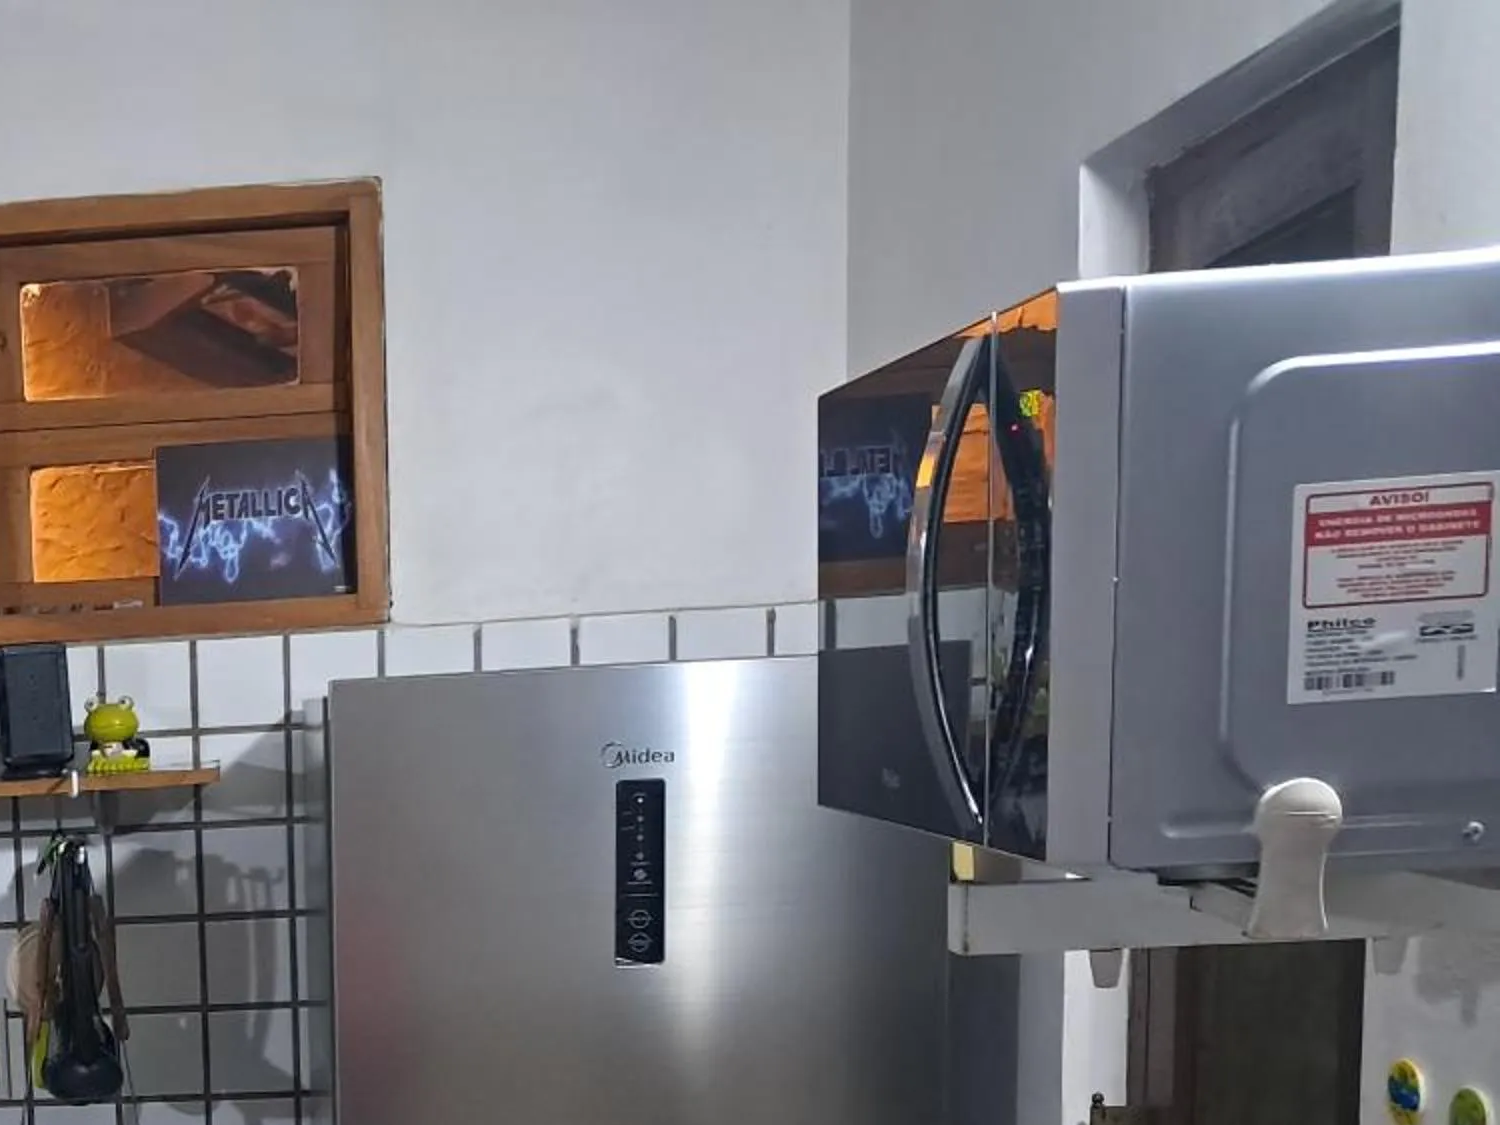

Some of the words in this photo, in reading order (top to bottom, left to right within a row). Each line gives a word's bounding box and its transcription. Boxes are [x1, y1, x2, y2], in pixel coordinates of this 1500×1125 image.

[1369, 491, 1429, 506] AVISO!
[175, 471, 341, 580] METALLICA
[606, 744, 675, 767] Midea
